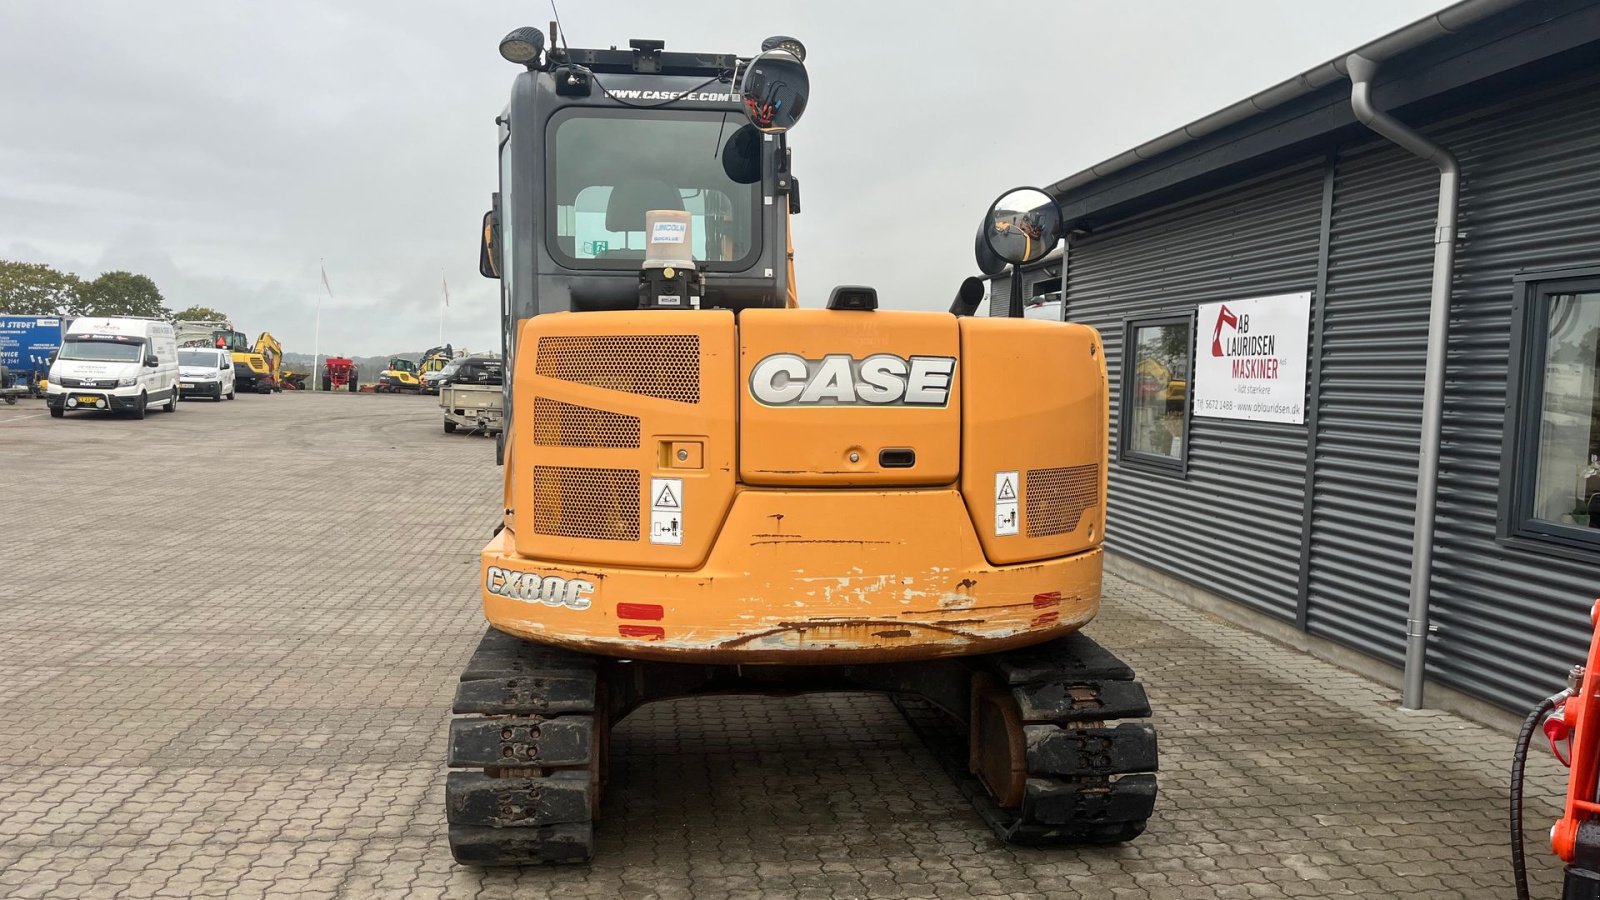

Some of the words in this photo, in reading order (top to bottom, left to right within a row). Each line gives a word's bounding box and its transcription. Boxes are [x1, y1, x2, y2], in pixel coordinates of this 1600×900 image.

[655, 223, 685, 233] LINCOLN
[7, 321, 36, 329] STEDET
[1237, 314, 1250, 334] AB
[1227, 335, 1275, 356] LAURIDSEN
[1232, 358, 1278, 379] MASKINER
[750, 354, 956, 406] CASE
[1247, 385, 1271, 395] stærkere
[1206, 399, 1218, 410] 5672
[1219, 400, 1232, 411] 1488
[1237, 402, 1301, 415] www.ablauridsen.dk
[487, 565, 594, 610] CX80C
